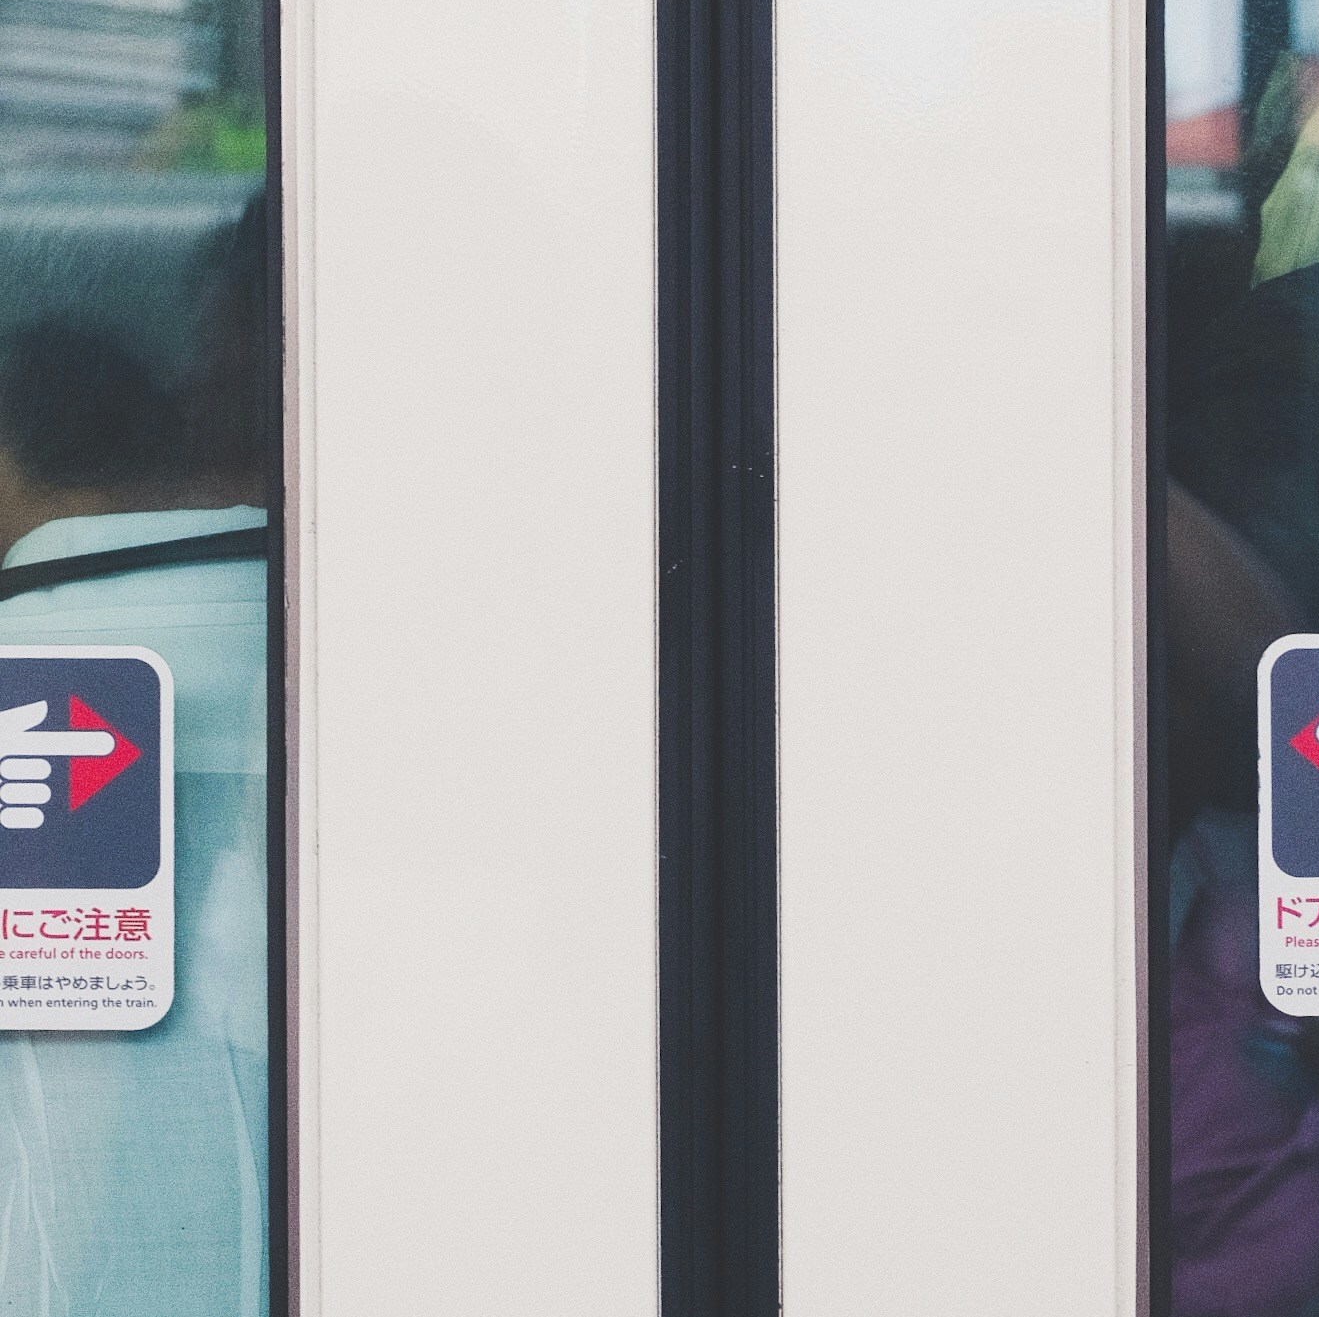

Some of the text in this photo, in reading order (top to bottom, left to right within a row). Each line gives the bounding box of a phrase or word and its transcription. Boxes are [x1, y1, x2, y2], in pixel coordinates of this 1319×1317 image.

[2, 907, 152, 942] にご注意
[9, 947, 57, 959] careful
[60, 947, 75, 959] of
[79, 947, 102, 959] the
[105, 947, 149, 959] doors.
[2, 975, 156, 991] 乗車はやめましょう。
[1276, 985, 1294, 996] Do
[1297, 985, 1318, 995] not
[7, 997, 42, 1008] when
[46, 997, 98, 1011] entering
[102, 997, 122, 1008] the
[125, 997, 158, 1008] train.
